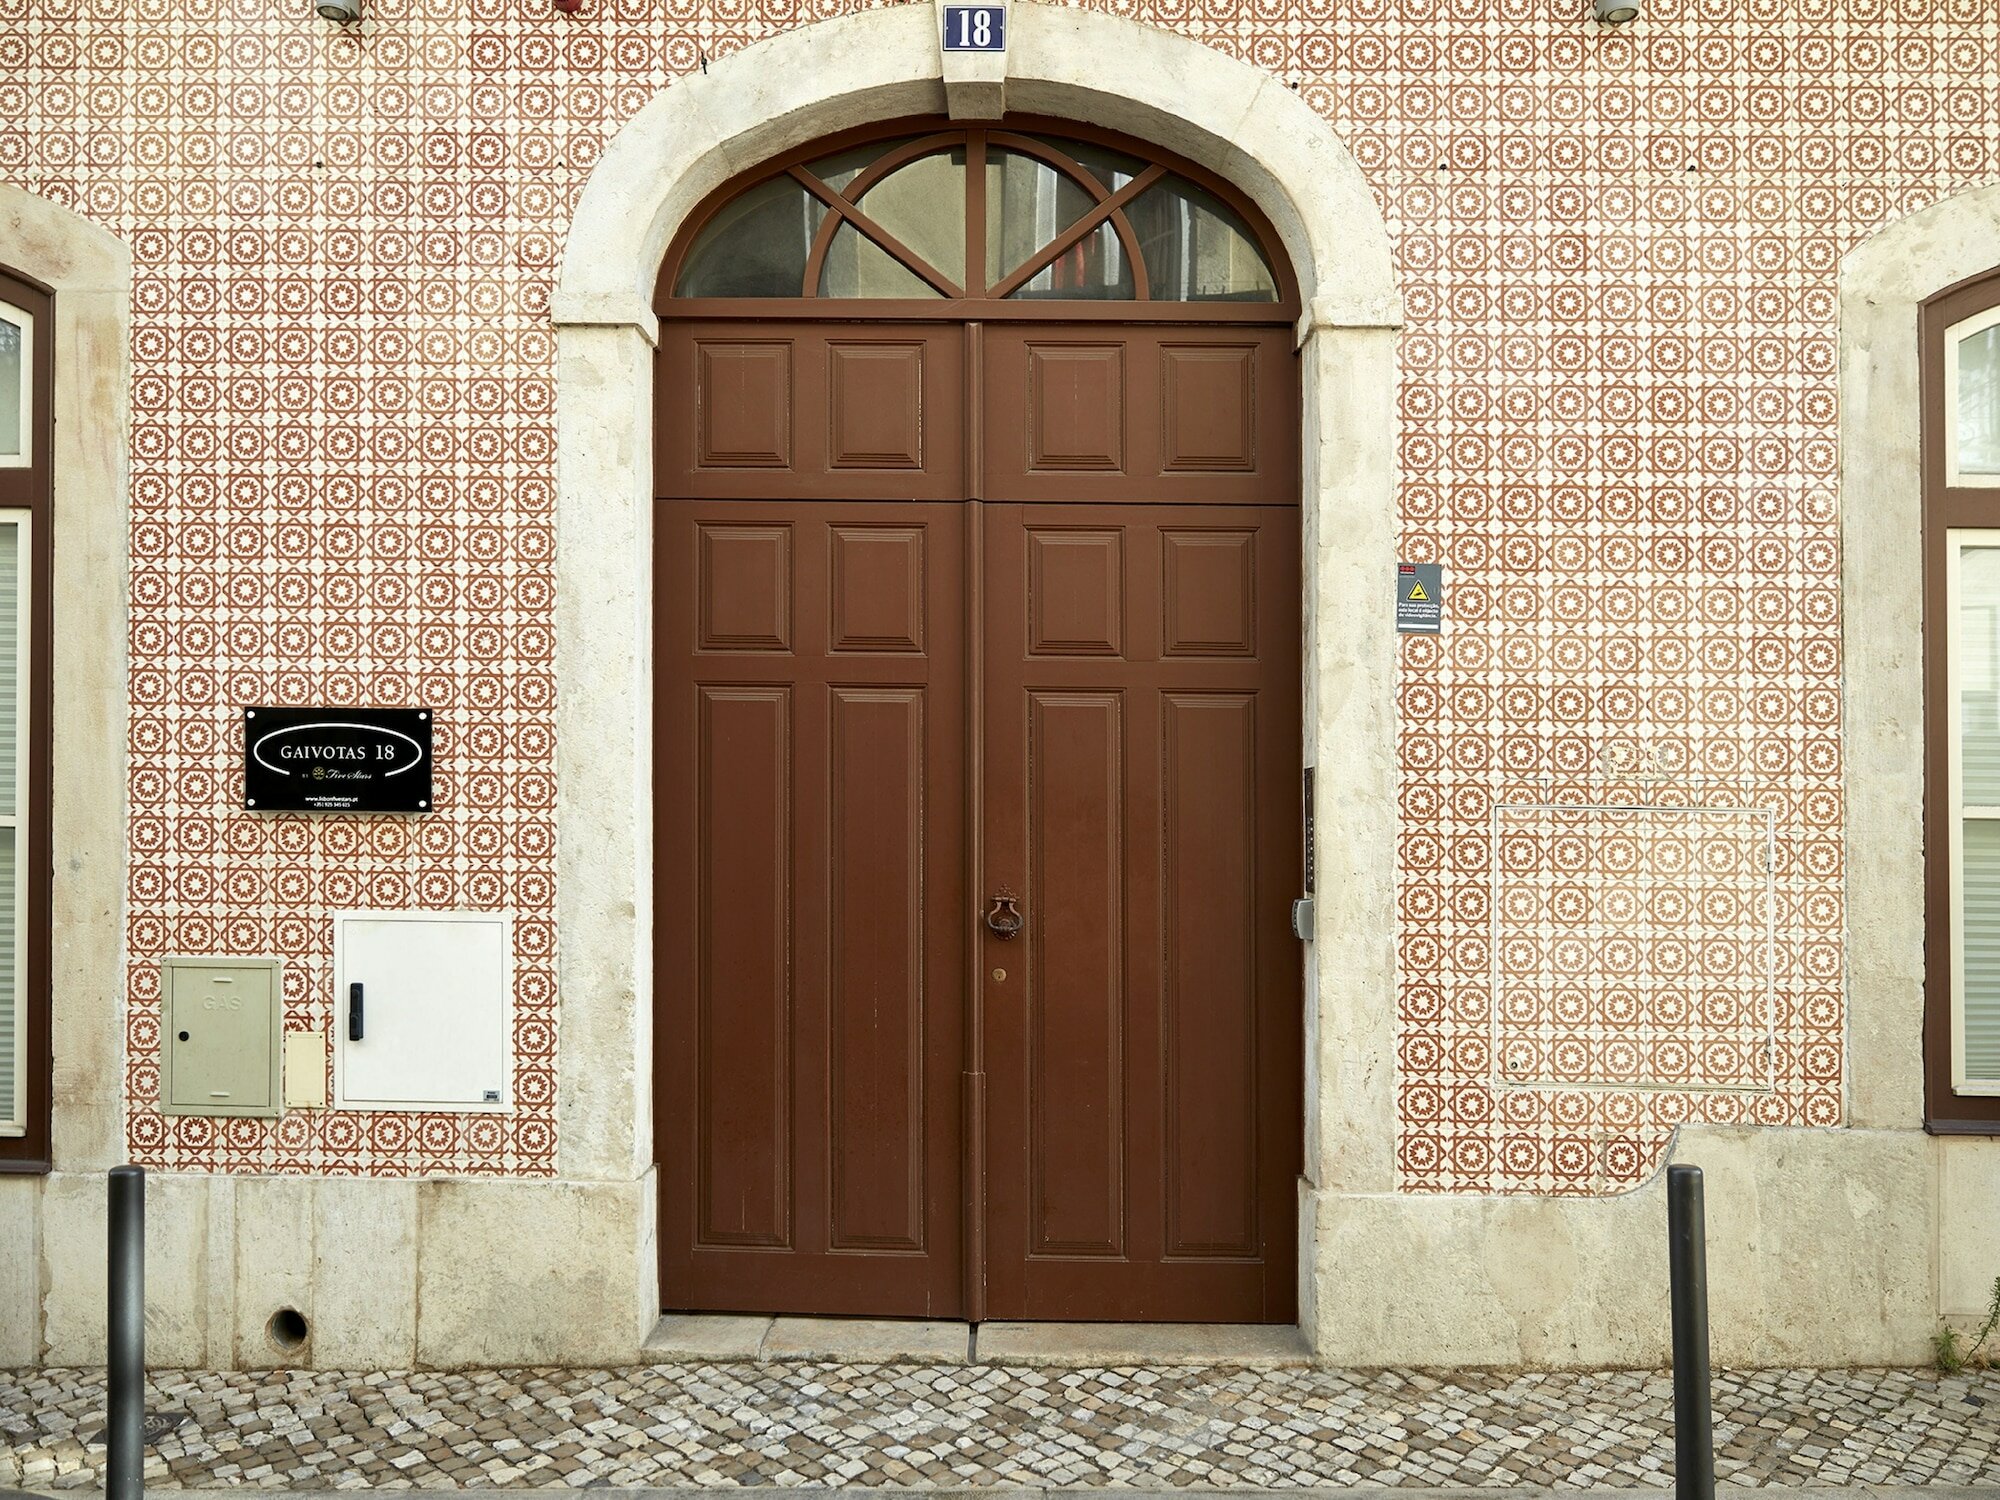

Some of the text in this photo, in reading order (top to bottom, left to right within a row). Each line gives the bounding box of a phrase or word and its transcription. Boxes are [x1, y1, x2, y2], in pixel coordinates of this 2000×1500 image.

[958, 9, 991, 47] 18
[280, 744, 395, 761] GAIVOTAS 18
[325, 768, 347, 780] Five
[347, 769, 372, 780] Stars
